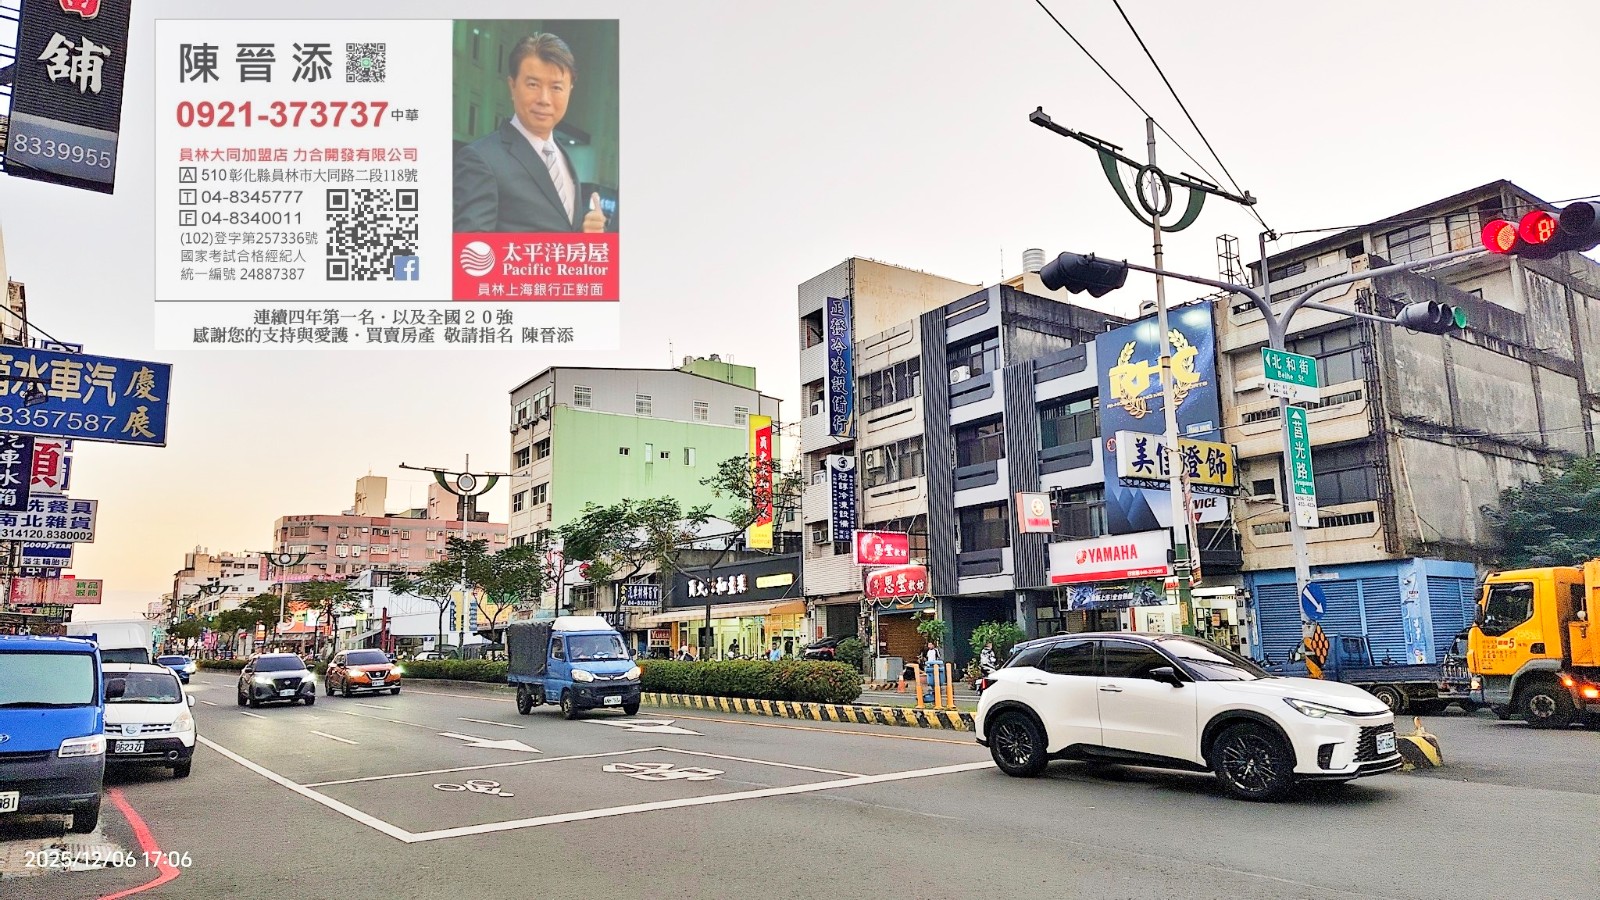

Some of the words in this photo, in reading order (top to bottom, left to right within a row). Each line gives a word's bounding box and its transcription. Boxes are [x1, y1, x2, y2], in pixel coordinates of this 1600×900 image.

[14, 134, 111, 168] 8339955
[1271, 353, 1308, 375] 北和街
[0, 406, 117, 433] 8357587
[1291, 420, 1308, 480] 莒光路
[0, 513, 91, 530] 南北雜貨
[1027, 518, 1050, 527] YAMAHA
[1088, 544, 1138, 563] YAMAHA
[1508, 637, 1515, 649] 5
